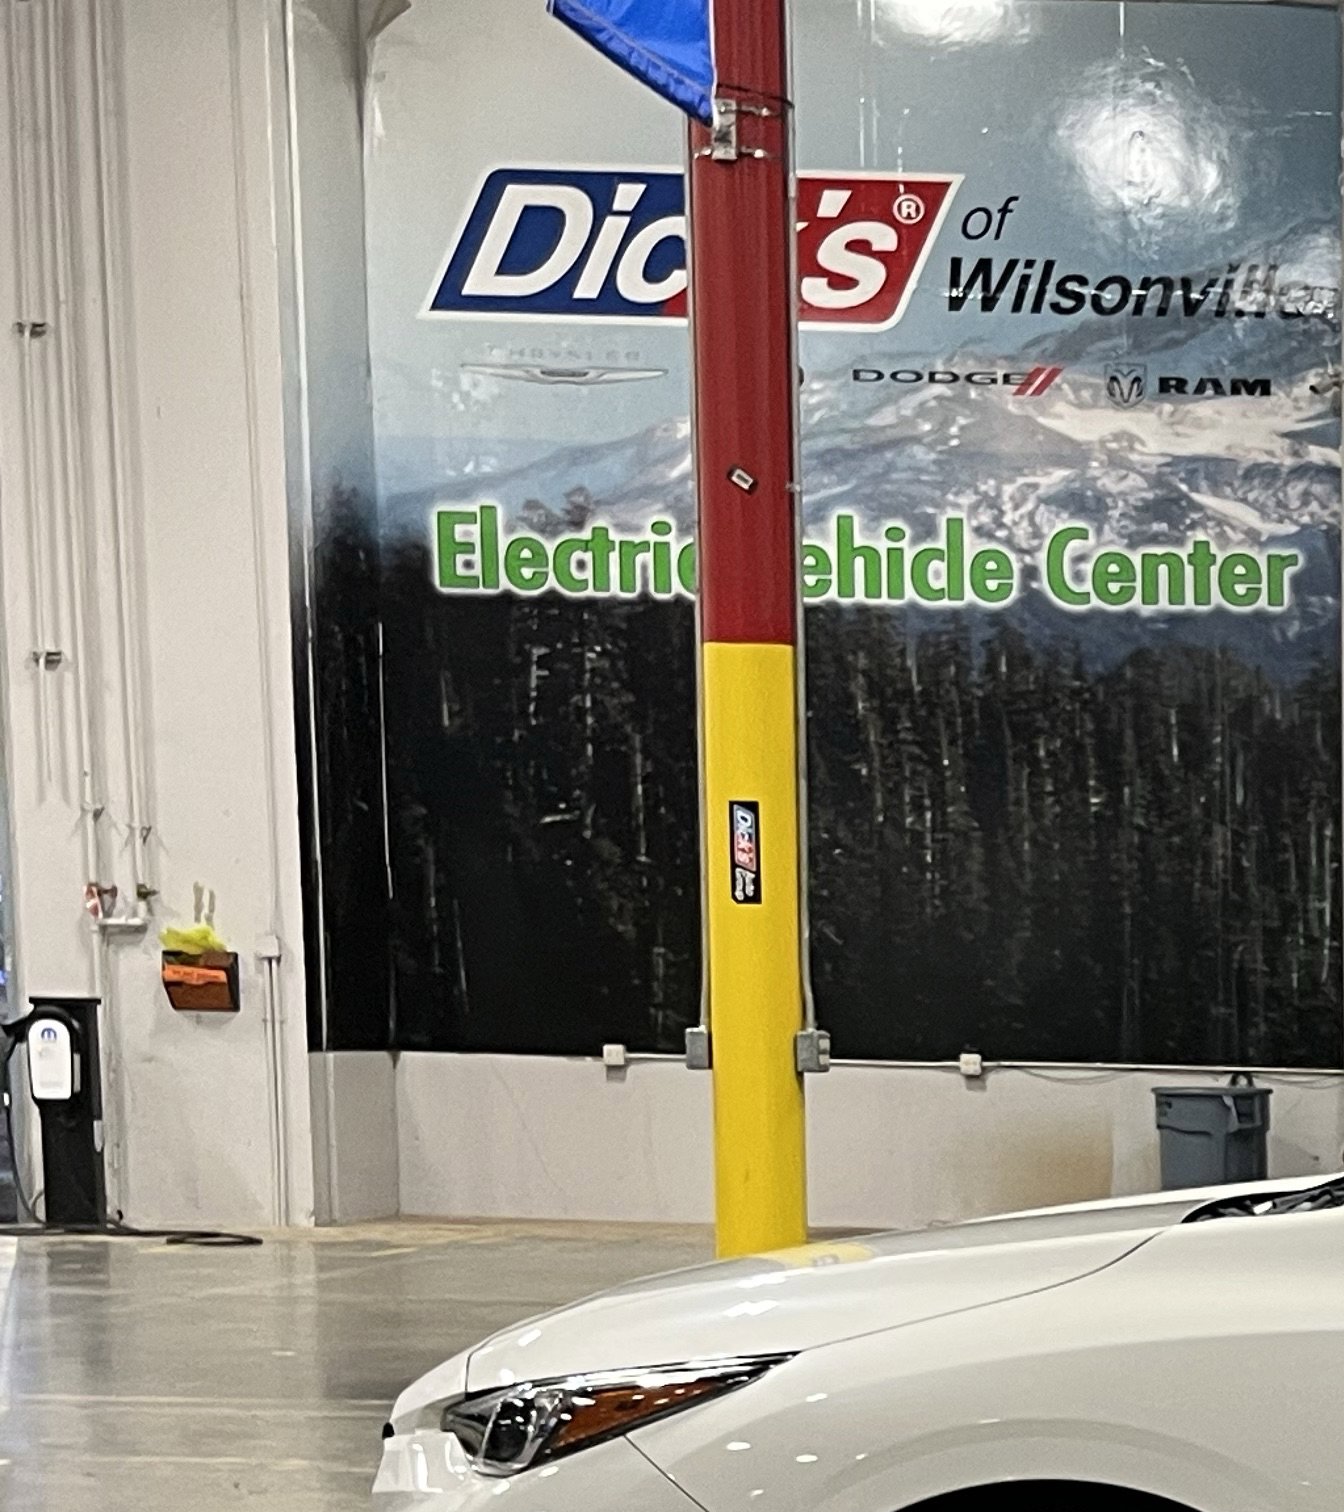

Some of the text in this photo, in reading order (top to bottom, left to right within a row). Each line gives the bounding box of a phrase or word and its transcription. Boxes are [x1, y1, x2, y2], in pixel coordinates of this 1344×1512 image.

[961, 196, 1019, 240] of
[852, 368, 1034, 386] DODGE
[1158, 376, 1272, 397] RAM
[802, 515, 1014, 602] ehicle
[1047, 526, 1298, 606] Center
